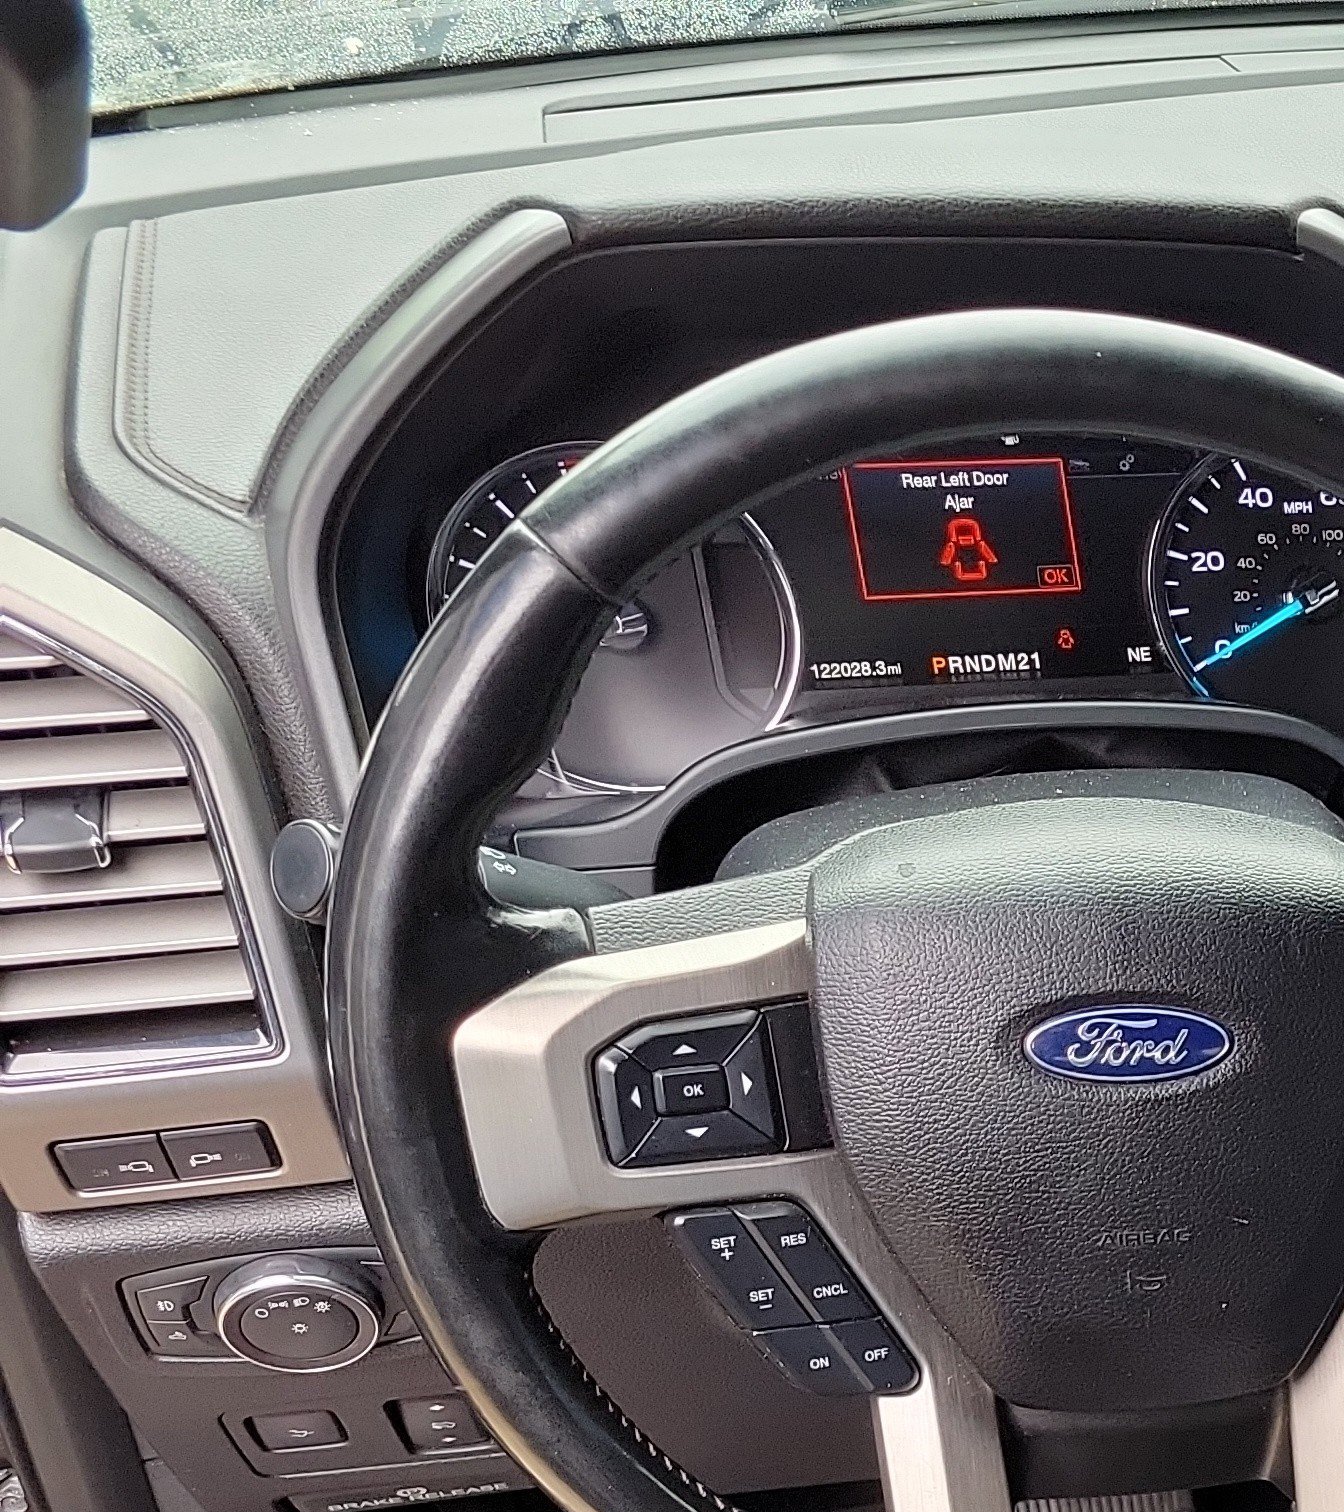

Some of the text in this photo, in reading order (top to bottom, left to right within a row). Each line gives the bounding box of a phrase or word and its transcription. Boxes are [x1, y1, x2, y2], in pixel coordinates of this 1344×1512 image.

[902, 471, 1009, 489] Rear Left Door
[944, 494, 975, 512] Ajar
[1238, 487, 1273, 508] 40
[1284, 501, 1313, 514] MPH
[1291, 523, 1310, 536] 80
[1322, 529, 1343, 541] 100
[1257, 533, 1276, 545] 60
[1191, 551, 1225, 572] 20
[1237, 557, 1256, 569] 40
[1044, 569, 1069, 584] OK
[1233, 590, 1251, 602] 20
[1128, 647, 1152, 662] NE
[1067, 1017, 1189, 1067] Ford
[683, 1083, 705, 1097] OK
[711, 1236, 737, 1250] SET
[780, 1232, 807, 1248] RES
[1100, 1228, 1193, 1248] AIRBAG
[749, 1288, 774, 1302] SET
[812, 1283, 848, 1299] CNCL
[864, 1347, 889, 1362] OFF
[809, 1356, 830, 1370] ON
[328, 1496, 403, 1512] BRAKE
